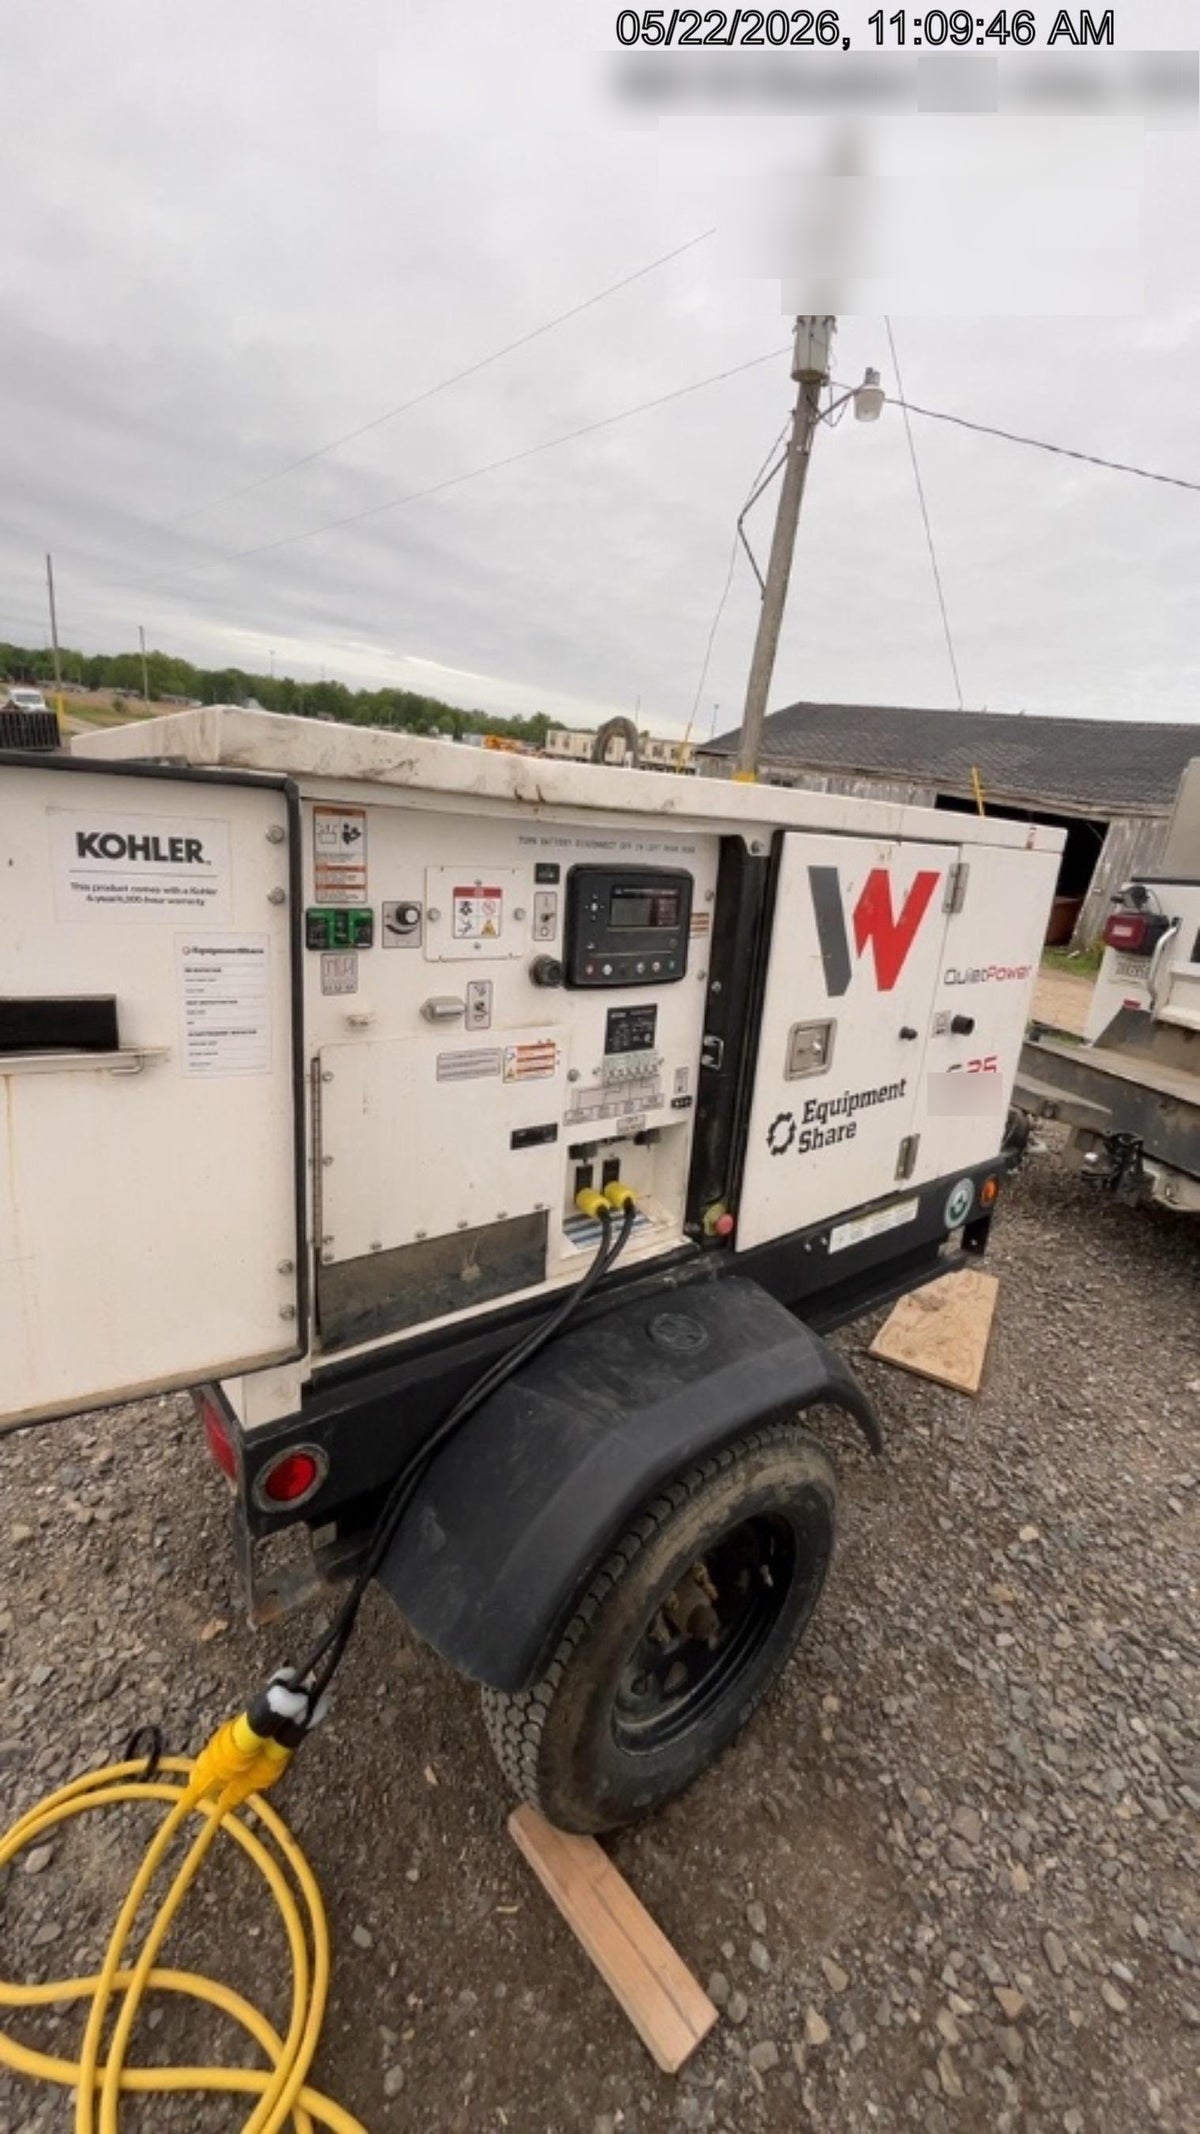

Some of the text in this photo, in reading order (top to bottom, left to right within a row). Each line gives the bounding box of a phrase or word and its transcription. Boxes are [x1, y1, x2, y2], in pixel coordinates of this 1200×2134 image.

[76, 832, 204, 863] KOHLER
[944, 965, 1032, 985] QuietPower
[801, 1078, 906, 1125] Equipment
[798, 1121, 857, 1154] Share
